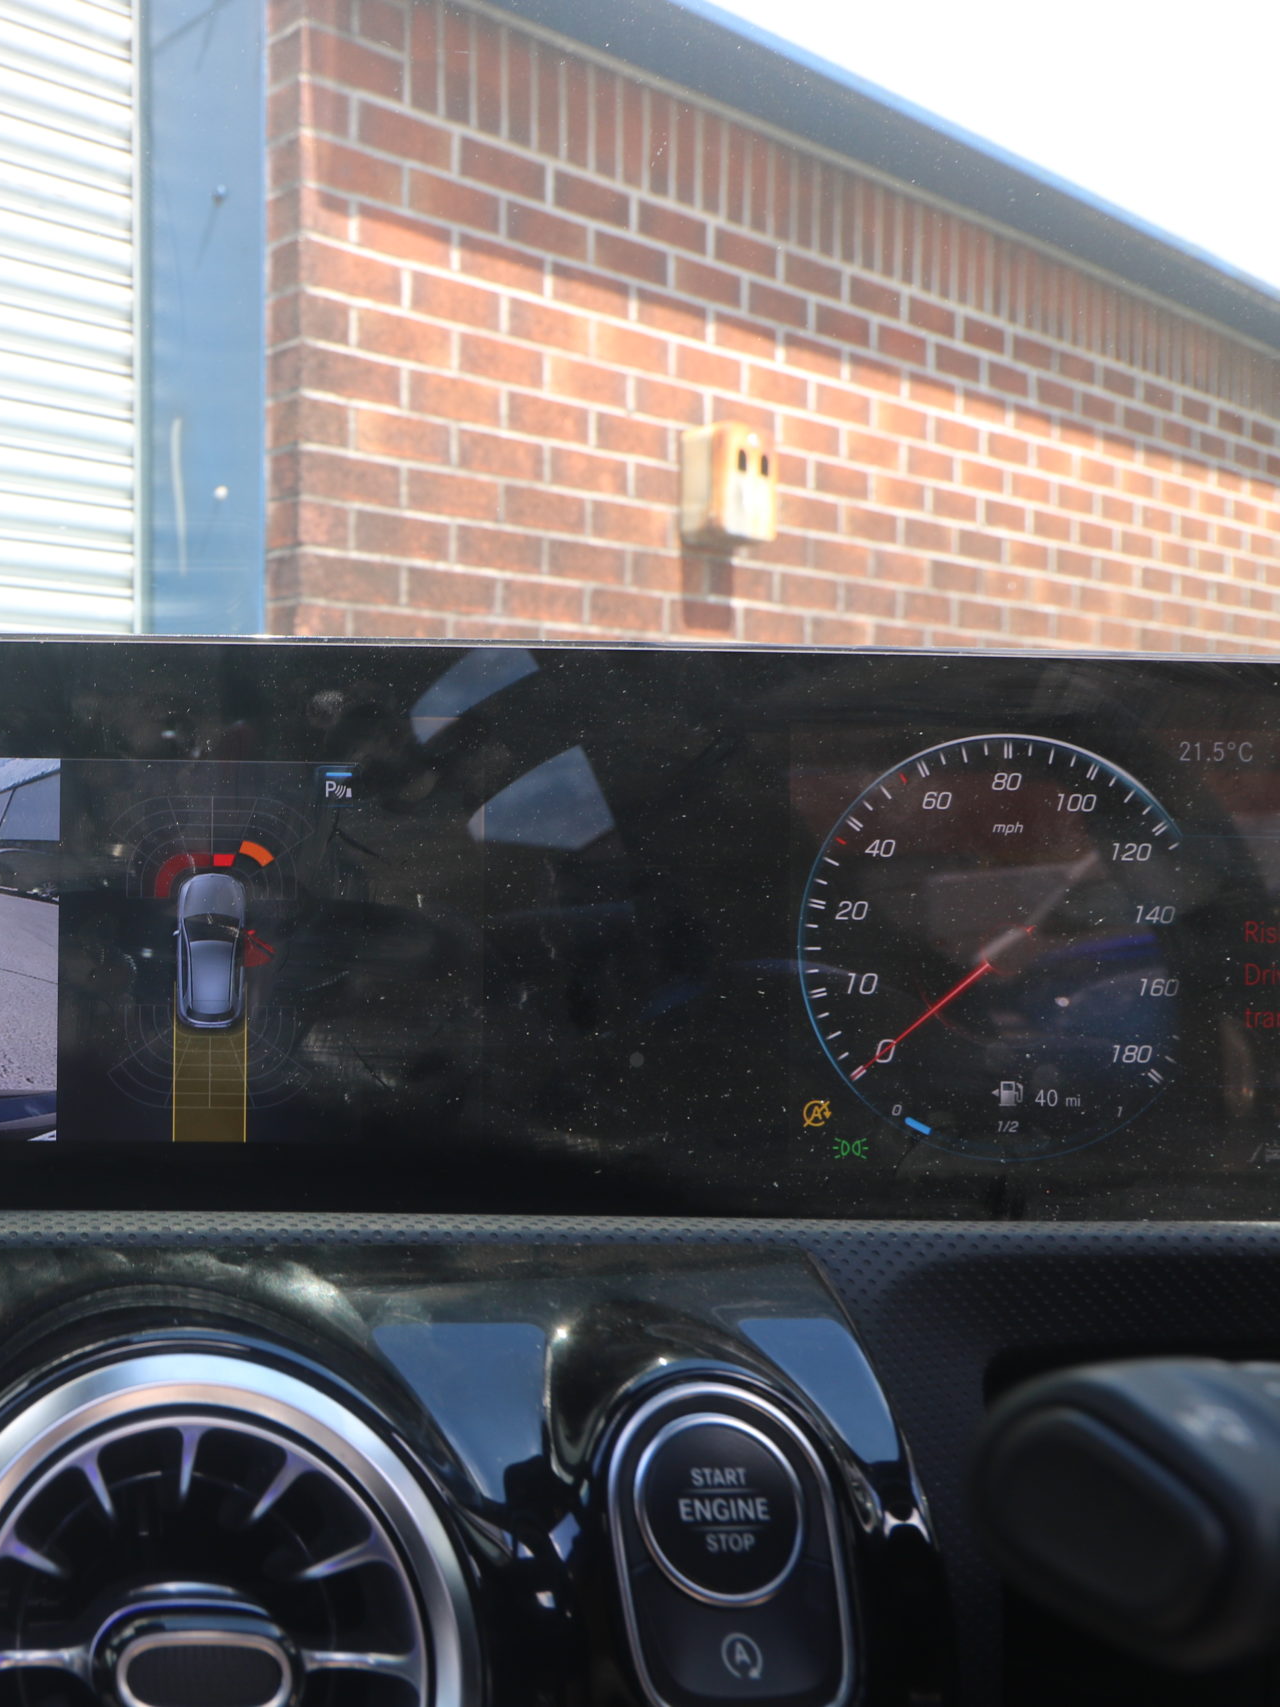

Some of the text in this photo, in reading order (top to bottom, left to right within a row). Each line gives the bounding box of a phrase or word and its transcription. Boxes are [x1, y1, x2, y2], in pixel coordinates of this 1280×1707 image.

[991, 772, 1022, 791] 80
[922, 791, 952, 810] 60
[1056, 793, 1097, 812] 100
[992, 821, 1024, 836] mph
[865, 839, 896, 858] 40
[1112, 843, 1152, 862] 120
[835, 901, 869, 920] 20
[1135, 905, 1176, 924] 140
[1244, 920, 1280, 944] Ris
[847, 973, 878, 995] 10
[1139, 978, 1180, 997] 160
[876, 1038, 896, 1064] 0
[1112, 1044, 1152, 1063] 180
[1034, 1089, 1081, 1107] 40 mi
[891, 1104, 902, 1116] 0
[997, 1120, 1019, 1133] 1/2
[690, 1467, 747, 1487] START
[679, 1498, 770, 1522] ENGINE
[706, 1533, 755, 1553] STOP
